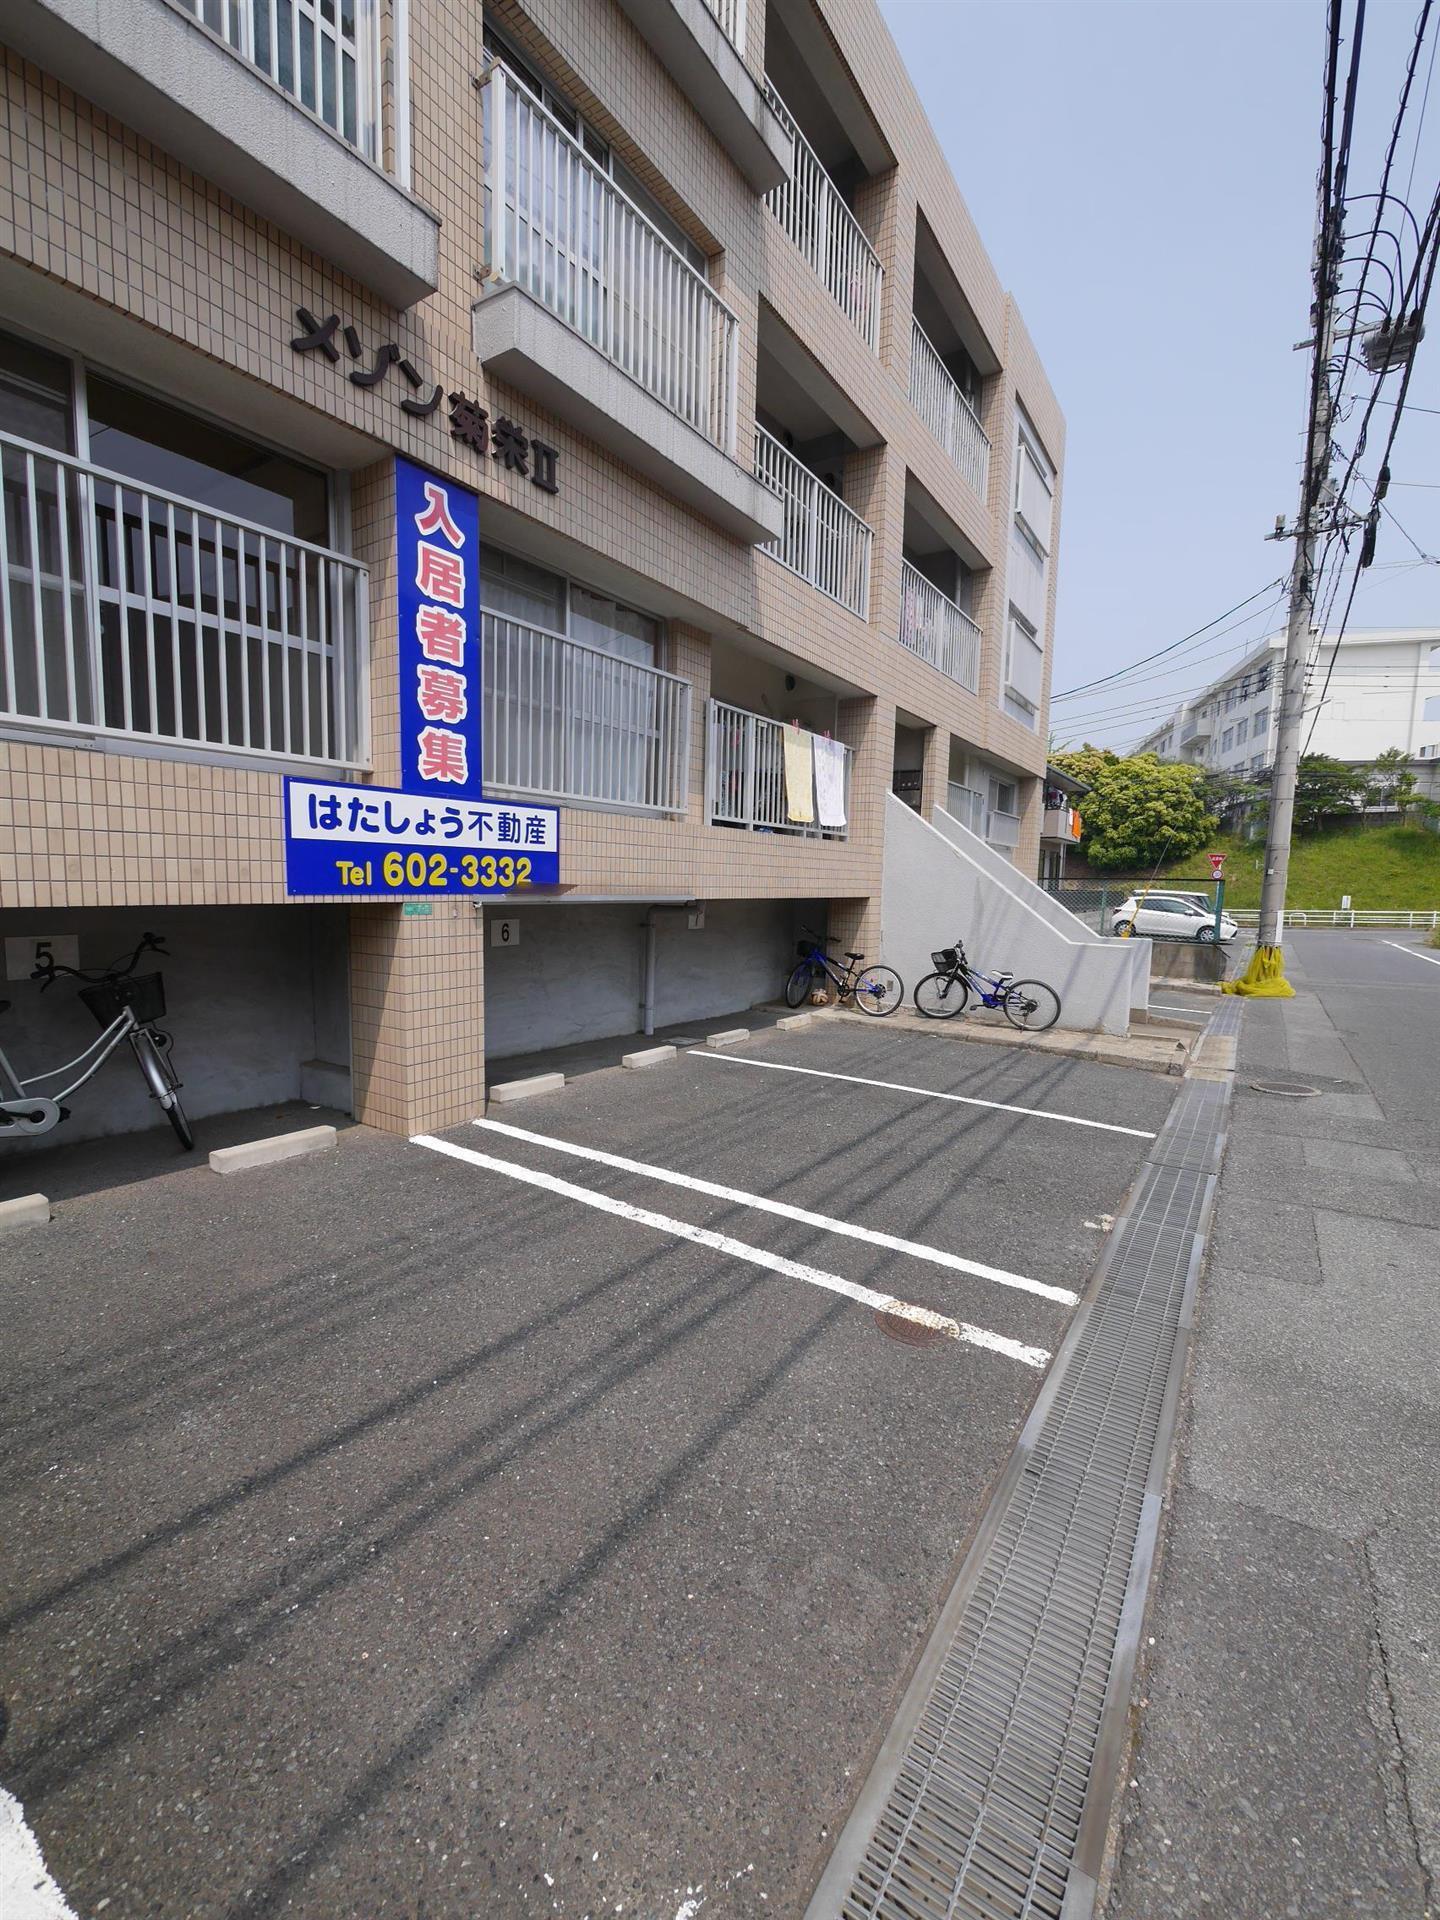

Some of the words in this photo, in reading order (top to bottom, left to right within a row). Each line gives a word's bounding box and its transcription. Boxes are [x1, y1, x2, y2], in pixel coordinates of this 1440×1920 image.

[415, 481, 469, 784] 入居者募集
[308, 793, 546, 845] はたしょう不動産
[336, 860, 372, 886] Tel
[383, 851, 532, 887] 602-3332
[501, 923, 510, 942] 6
[35, 942, 54, 970] 5
